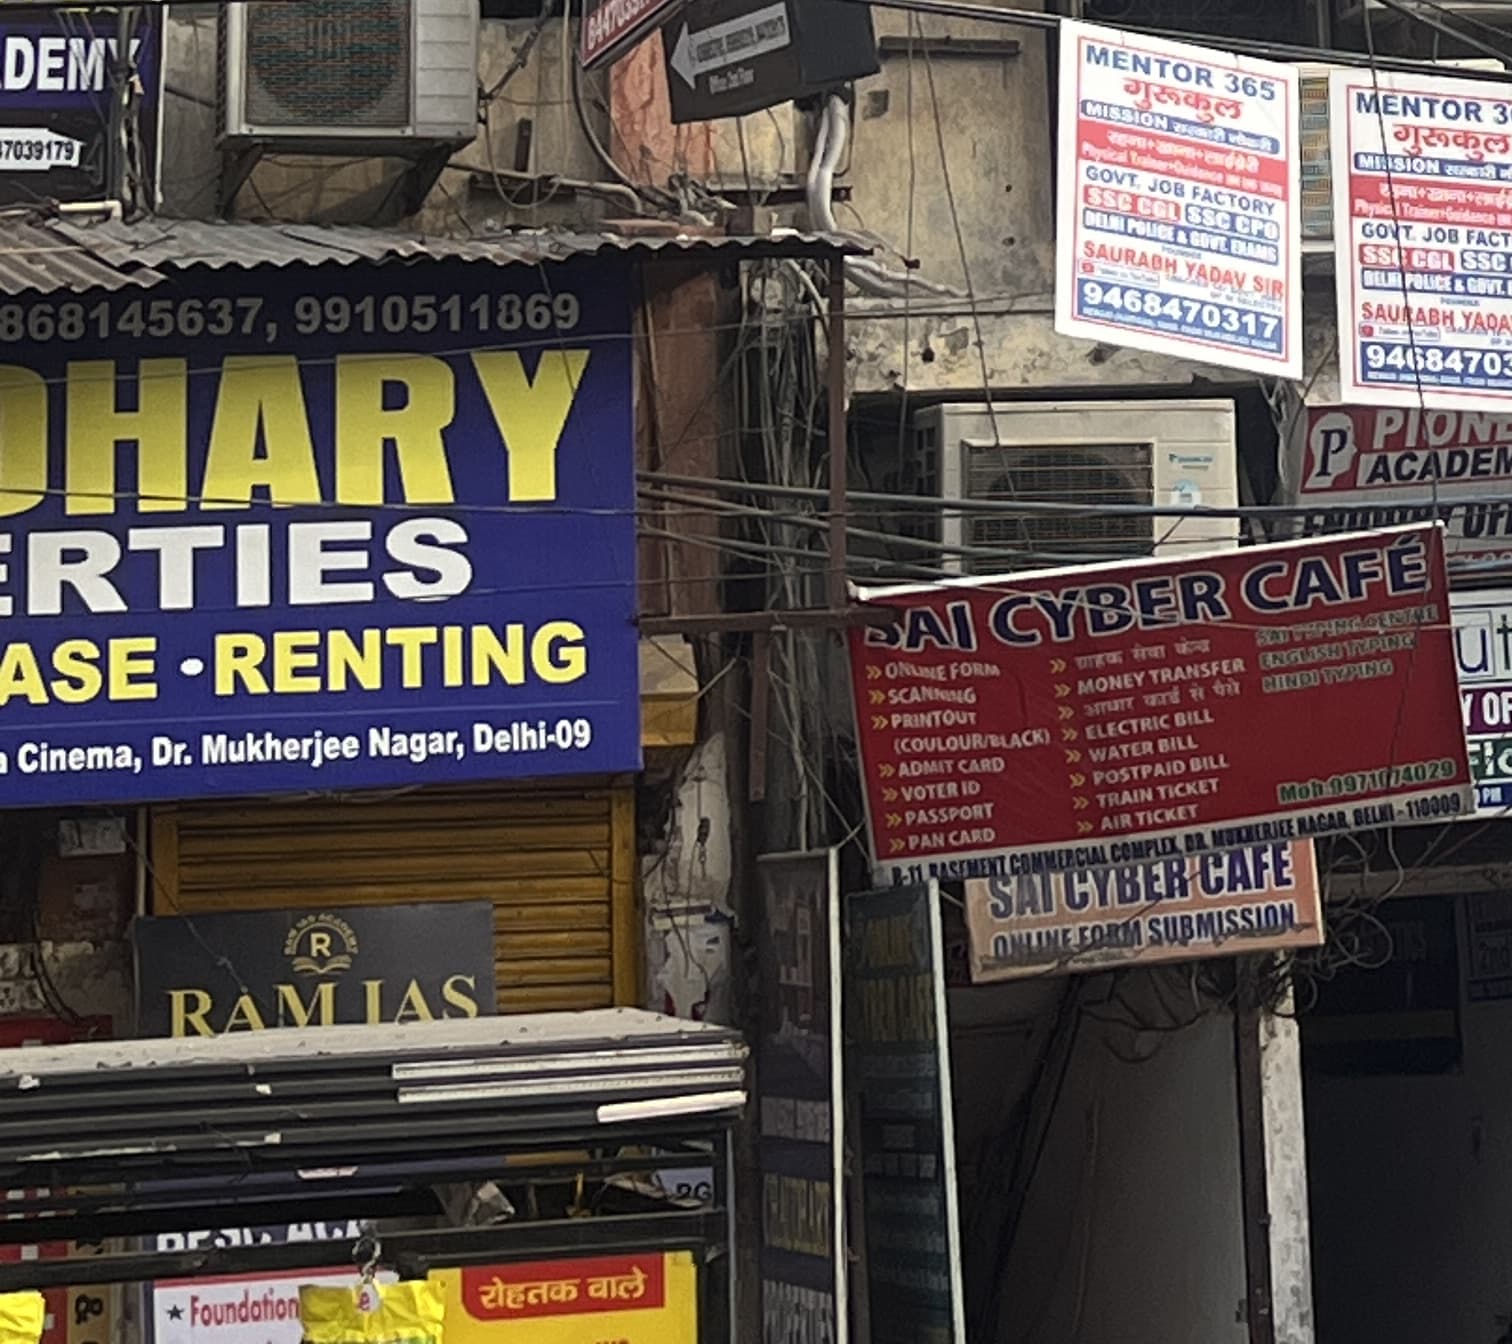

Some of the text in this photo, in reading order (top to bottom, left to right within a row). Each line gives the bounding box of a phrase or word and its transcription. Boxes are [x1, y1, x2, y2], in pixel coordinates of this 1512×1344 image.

[1086, 44, 1275, 101] MENTOR 365
[1356, 92, 1484, 123] MENTOR
[1148, 178, 1275, 216] JOB FACTORY
[1423, 227, 1459, 243] JOB
[1084, 240, 1177, 274] SAURABH
[1186, 261, 1246, 289] YADAV
[1253, 275, 1284, 297] SIR
[295, 291, 580, 335] 9910511869
[1083, 282, 1279, 340] 9468470317
[990, 575, 1232, 648] CYBER
[1240, 537, 1434, 614] CAFÉ
[214, 621, 588, 696] RENTING
[885, 663, 1001, 681] ONLINE FORM
[1077, 658, 1246, 696] MONEY TRANSFER
[888, 686, 976, 704] SCANNING
[891, 710, 976, 729] PRINTOUT
[17, 719, 592, 774] Cinema, Dr. Mukherjee Nagar, Delhi-09
[1096, 778, 1220, 808] TRAIN TICKET
[905, 803, 994, 825] PASSPORT
[909, 828, 996, 850] PAN CARD
[168, 974, 479, 1039] RAM IAS
[479, 1266, 648, 1310] रोहतक वाले
[190, 1288, 299, 1328] Foundation
